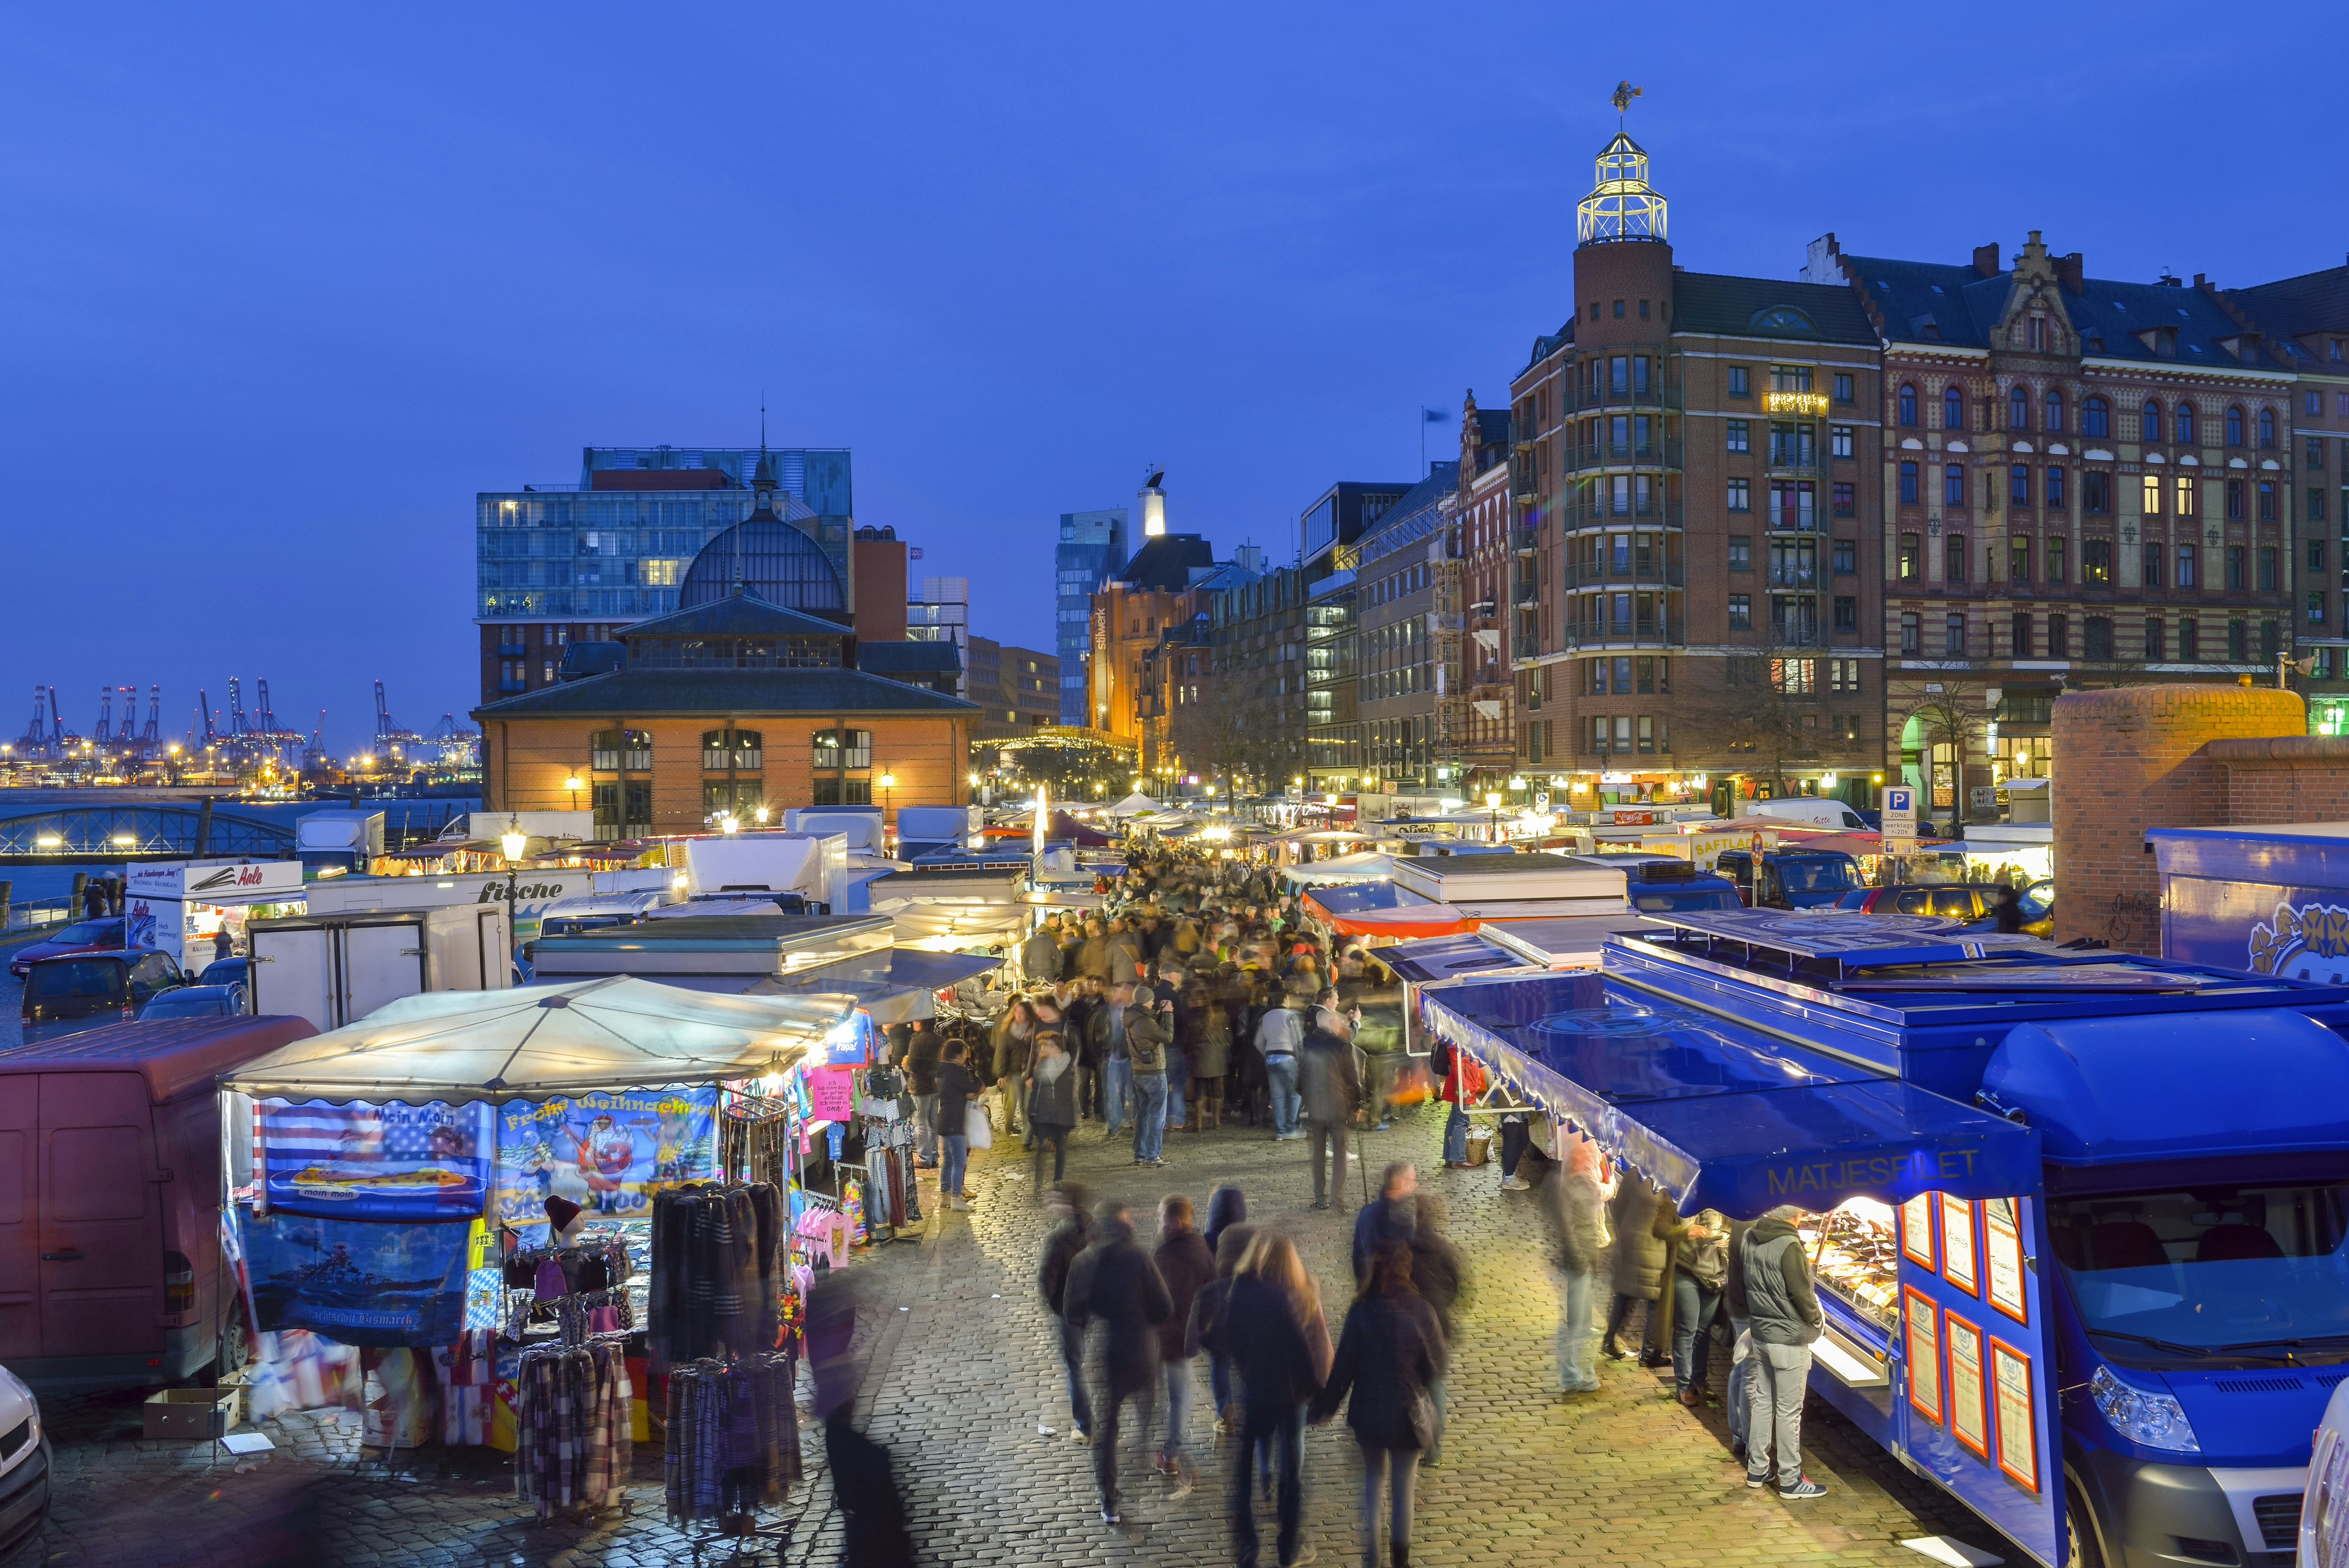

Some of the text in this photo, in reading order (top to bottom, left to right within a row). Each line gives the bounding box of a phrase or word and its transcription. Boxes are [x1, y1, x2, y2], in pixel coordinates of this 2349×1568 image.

[1094, 607, 1106, 650] stilwerk
[1893, 793, 1905, 808] P
[1813, 816, 1831, 825] Gitte
[237, 866, 263, 886] Aale
[469, 881, 563, 904] fische
[158, 931, 179, 939] unterwegs!
[836, 1041, 858, 1053] Papa!
[373, 1108, 455, 1126] Moin Moin
[505, 1094, 716, 1132] Frohe Weihnachten
[1767, 1149, 1979, 1195] MATJESFILET
[303, 1188, 354, 1199] moin moin
[1989, 1221, 2017, 1240] Sonderangebot
[358, 1313, 412, 1325] Bismarck
